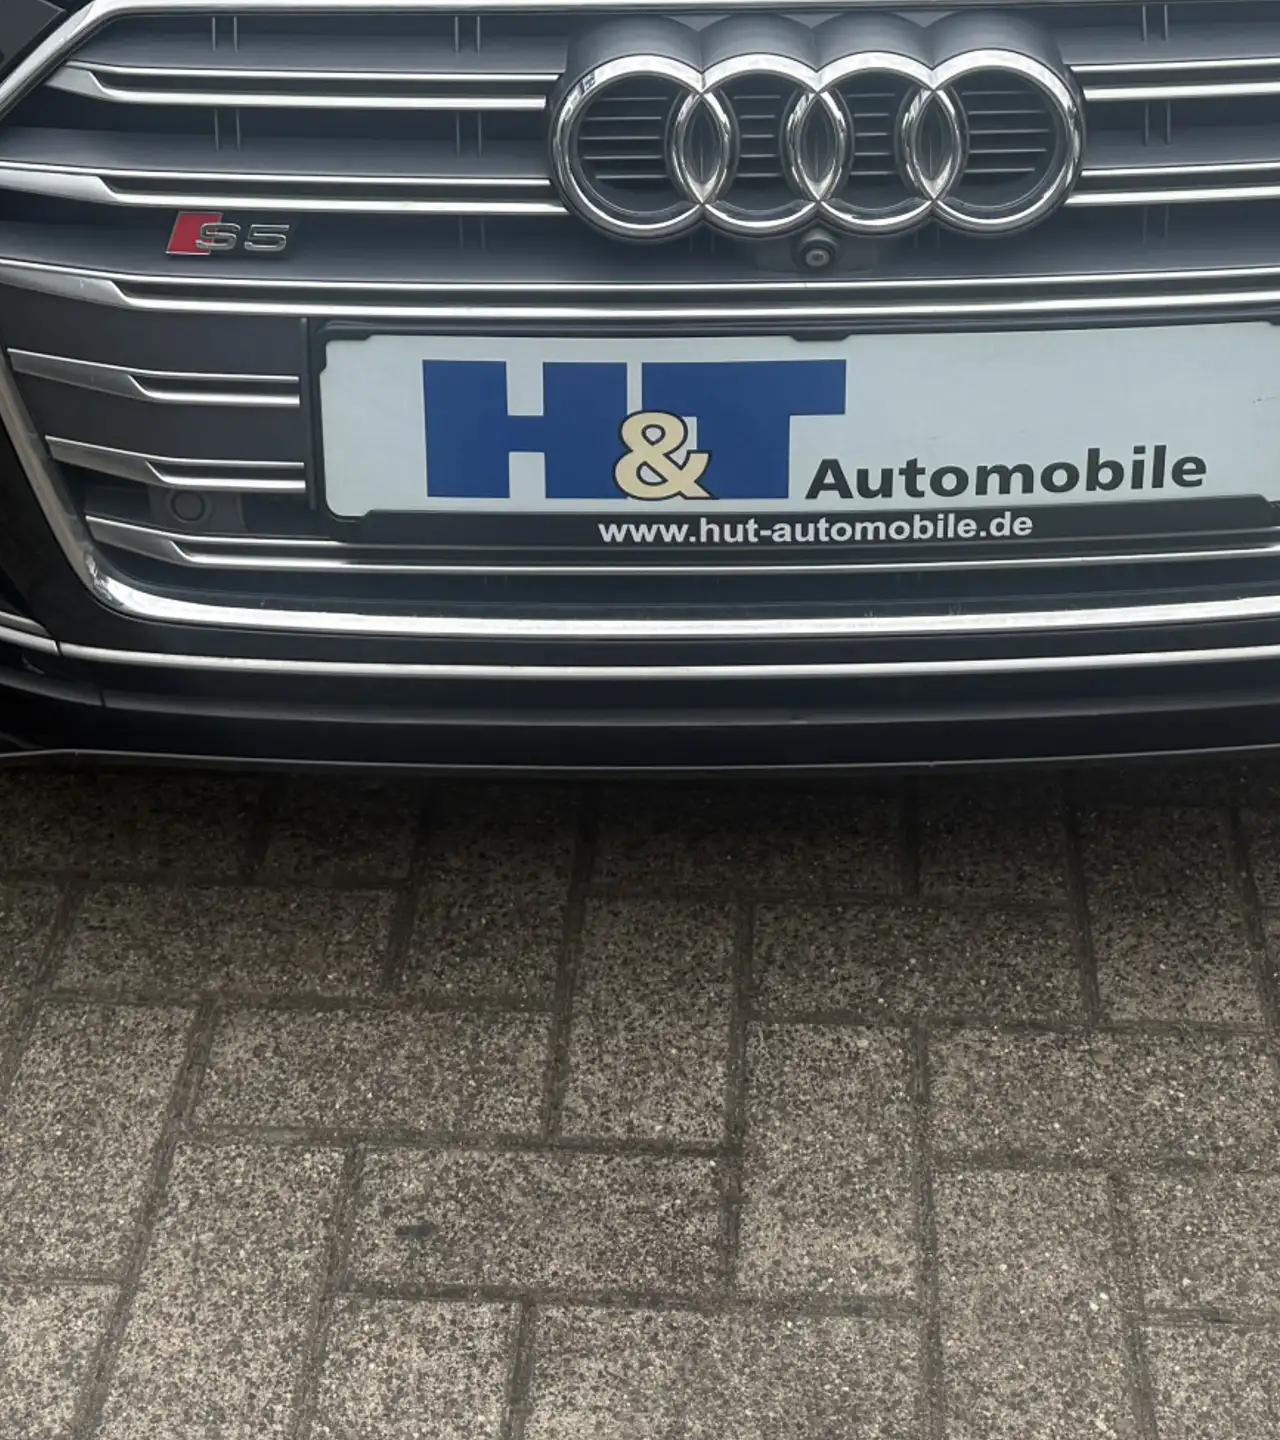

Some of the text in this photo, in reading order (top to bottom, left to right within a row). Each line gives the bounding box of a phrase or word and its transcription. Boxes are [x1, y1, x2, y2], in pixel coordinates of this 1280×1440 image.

[195, 221, 290, 252] S5
[422, 359, 1208, 501] H&T Automobile
[597, 510, 1034, 543] www.hut-automobile.de
